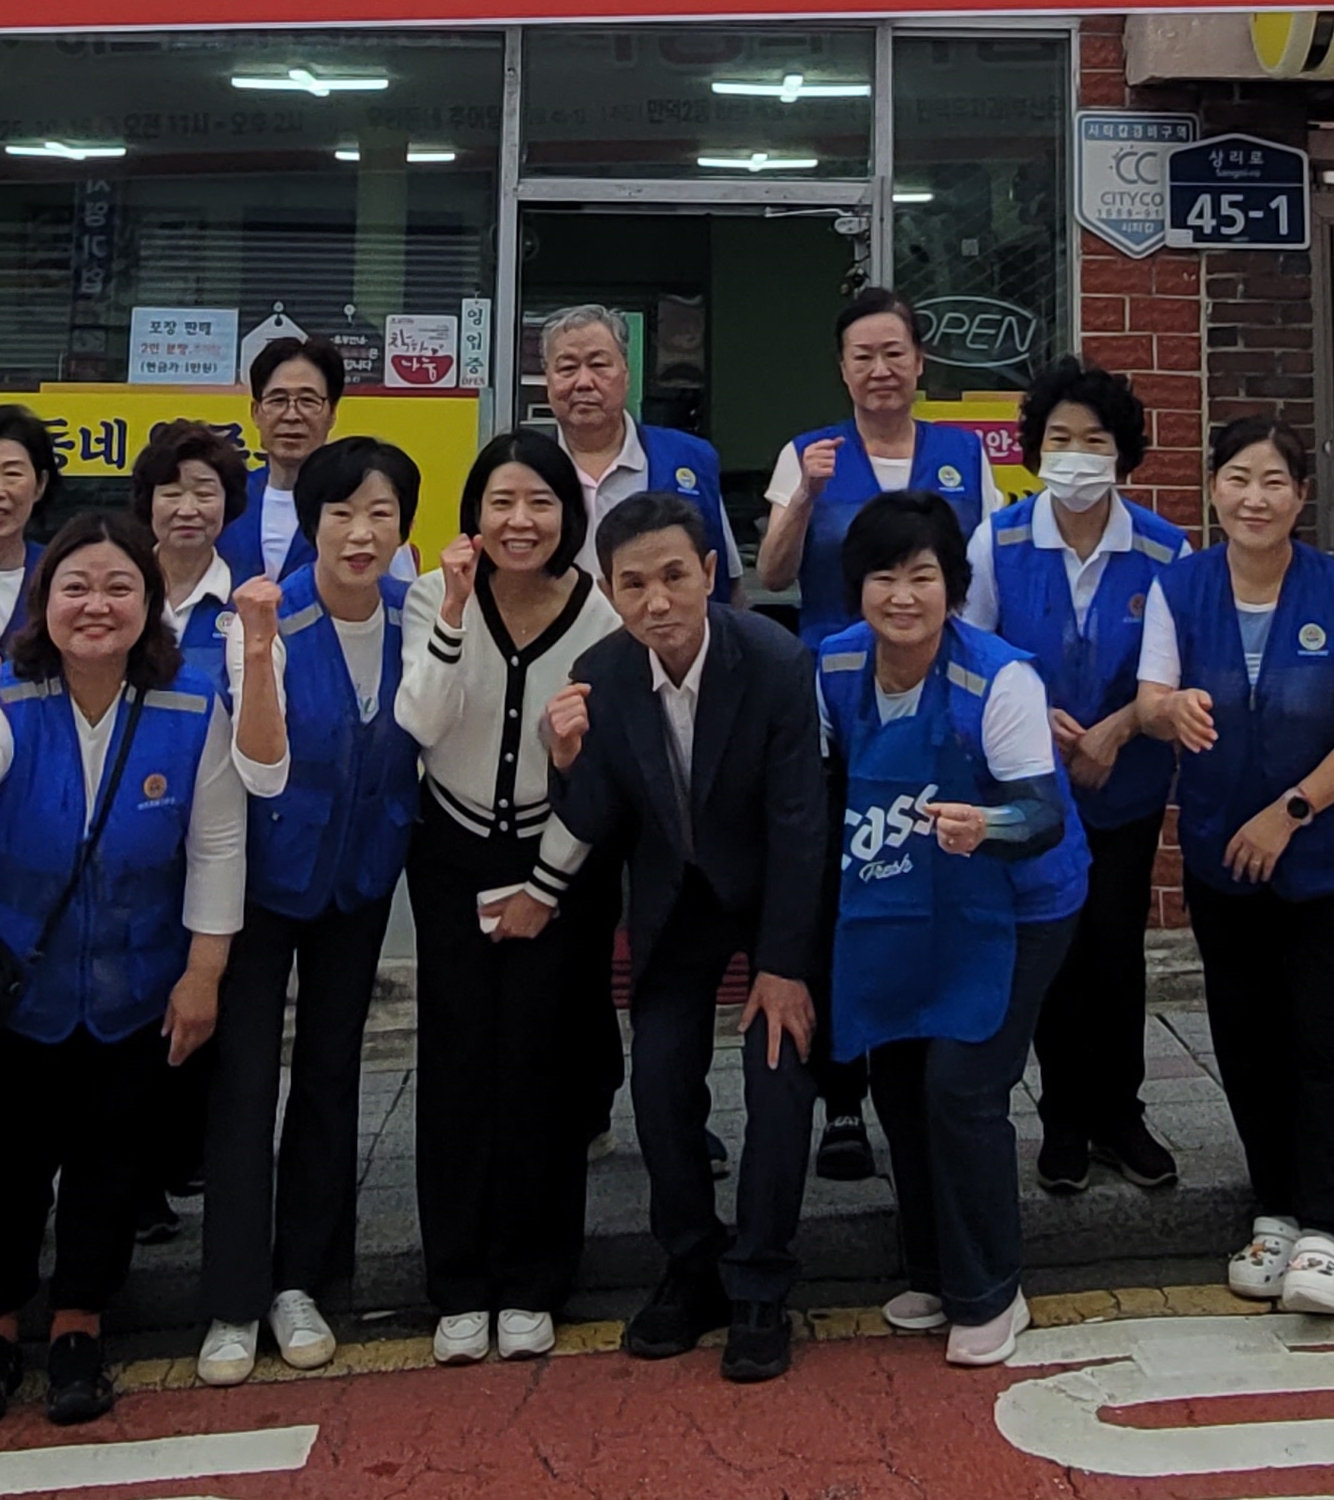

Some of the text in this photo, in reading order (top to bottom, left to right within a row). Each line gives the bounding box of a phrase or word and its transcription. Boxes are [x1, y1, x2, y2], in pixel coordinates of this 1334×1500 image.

[1208, 149, 1265, 168] 상리로
[1186, 193, 1289, 236] 45-1
[148, 320, 178, 336] 포장
